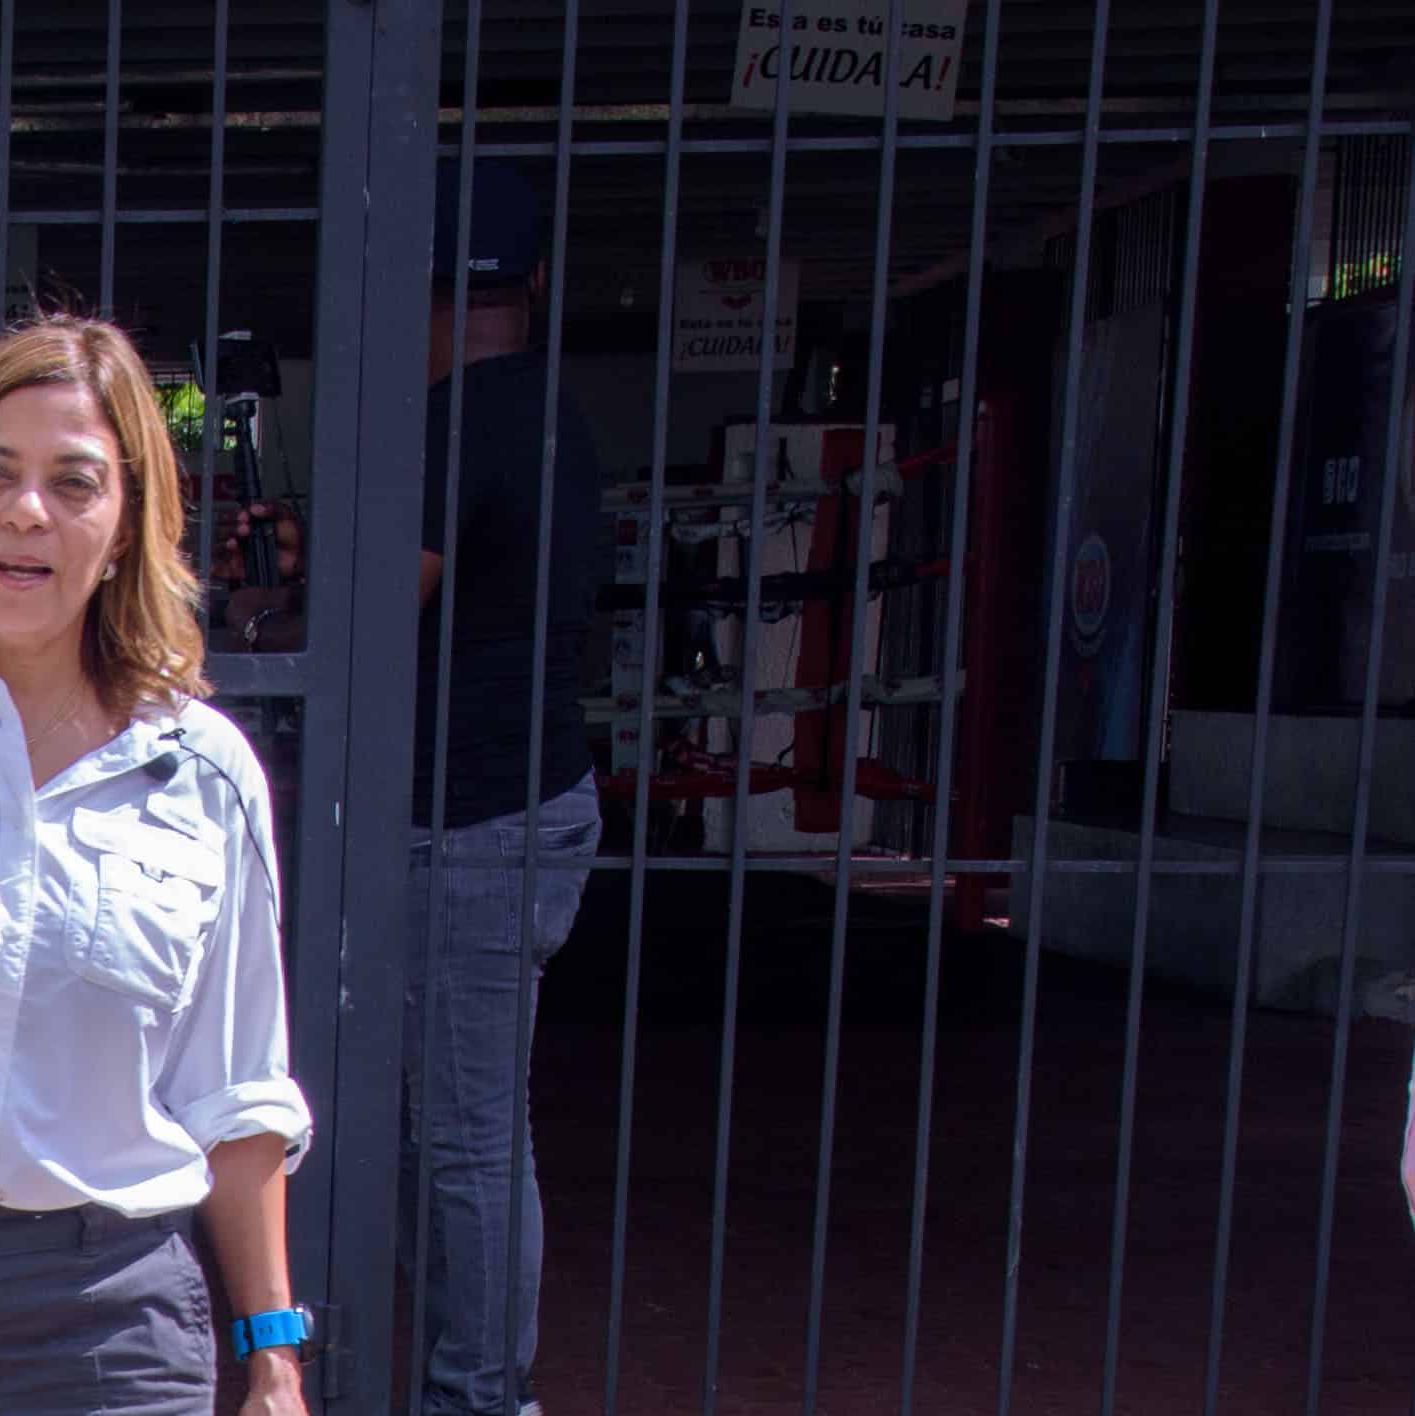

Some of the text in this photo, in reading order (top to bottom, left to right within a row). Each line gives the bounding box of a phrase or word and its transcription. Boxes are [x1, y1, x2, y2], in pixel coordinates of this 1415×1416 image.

[748, 8, 808, 31] Esa
[816, 15, 848, 33] es
[742, 45, 952, 92] ¡CUIDAA!
